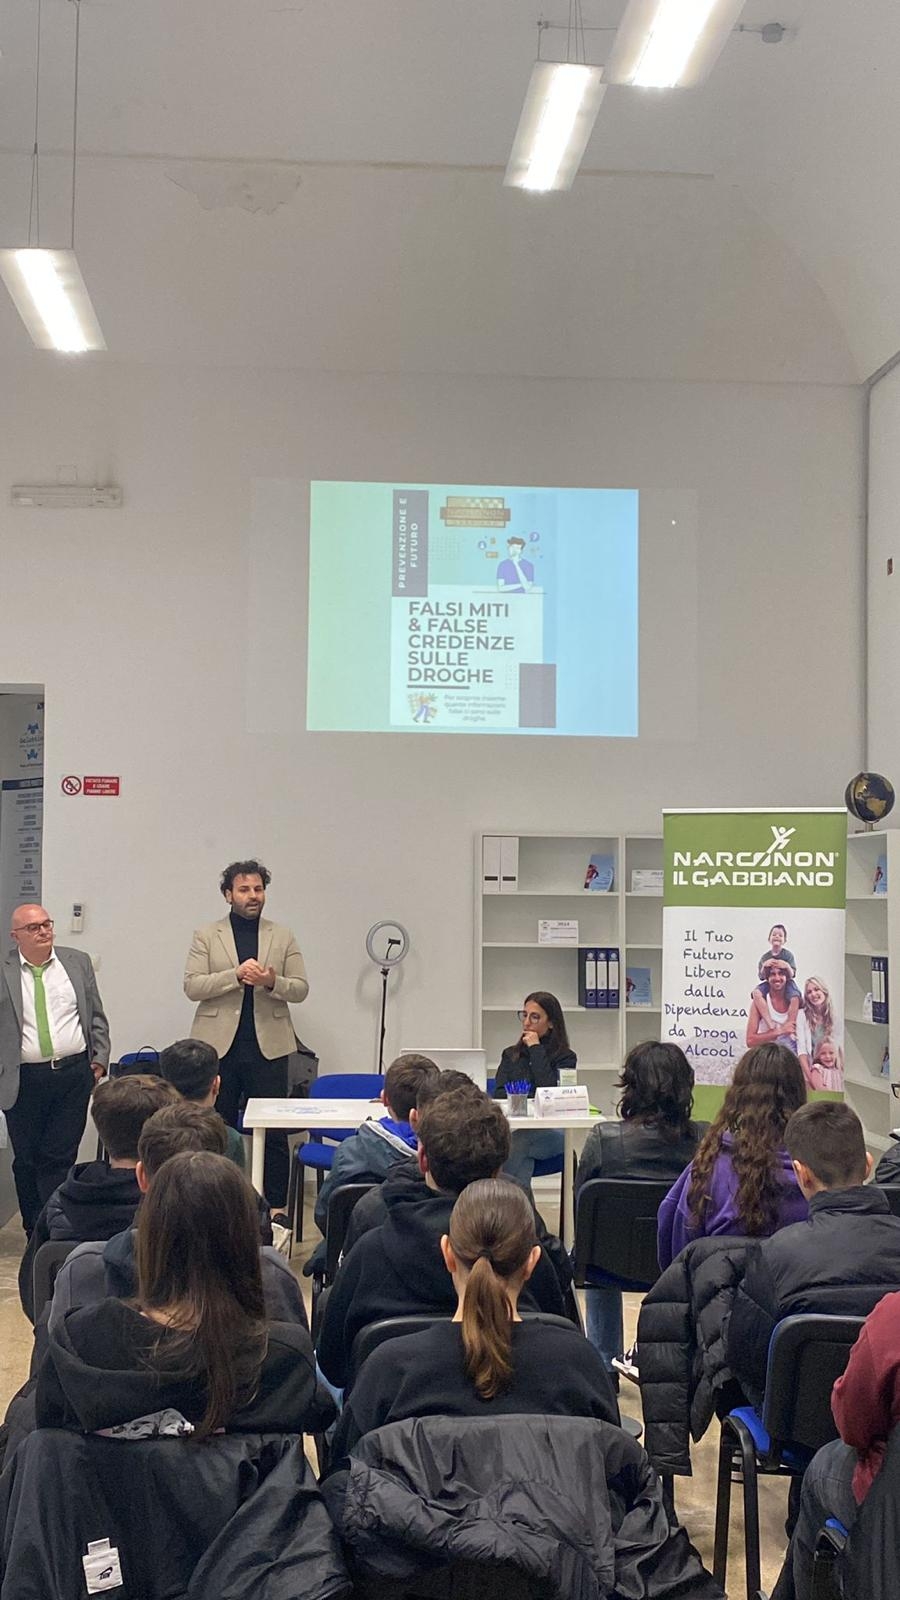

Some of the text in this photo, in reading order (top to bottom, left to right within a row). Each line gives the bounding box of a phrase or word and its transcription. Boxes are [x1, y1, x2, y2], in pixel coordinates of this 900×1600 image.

[398, 509, 406, 588] PREVENZIONE
[410, 523, 418, 568] FUTURO
[409, 601, 509, 617] FALSI MITI
[408, 617, 488, 633] & FALSE
[408, 634, 515, 650] CREDENZE
[407, 651, 469, 666] SULLE
[408, 667, 494, 683] DROGHE
[673, 871, 834, 887] IL GABBIANO
[684, 930, 734, 943] Il Tuo
[683, 948, 734, 961] Futuro
[685, 965, 731, 979] Libero
[684, 984, 725, 998] dalla
[664, 1003, 748, 1022] Dipendenza
[668, 1024, 738, 1043] da Droga
[685, 1044, 735, 1057] Alcool
